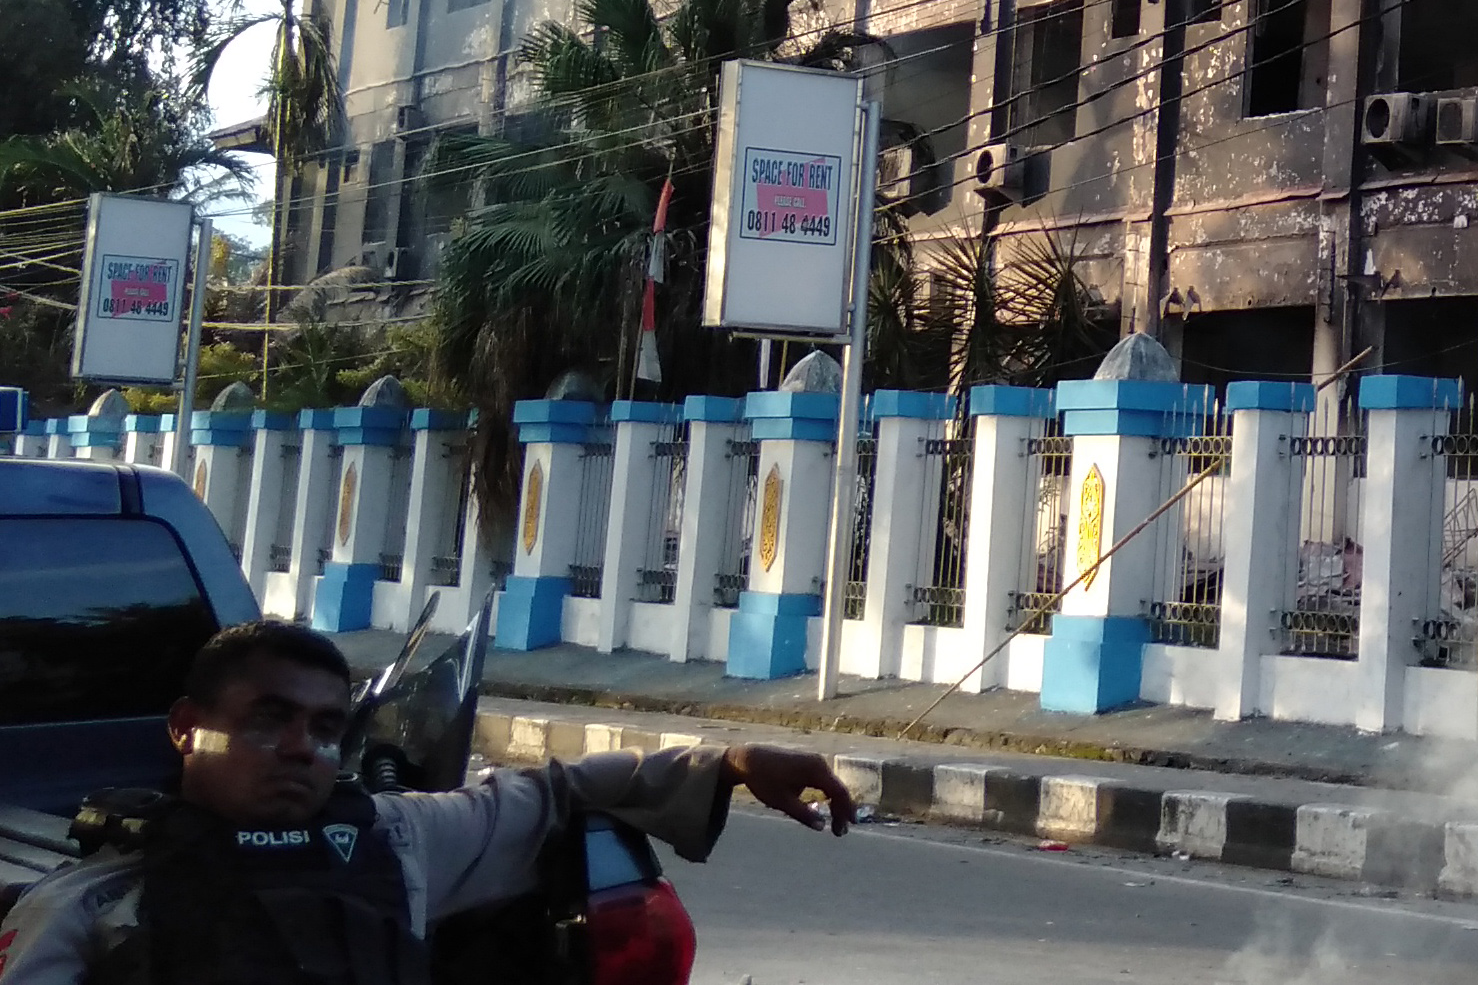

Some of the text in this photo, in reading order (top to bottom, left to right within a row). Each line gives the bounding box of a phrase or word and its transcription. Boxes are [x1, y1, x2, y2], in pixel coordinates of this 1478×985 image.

[752, 158, 833, 191] SPACE FOR RENT
[747, 209, 831, 237] 0811 48 4449
[103, 298, 126, 313] 0811
[145, 301, 169, 316] 4449
[237, 830, 310, 845] POLISI
